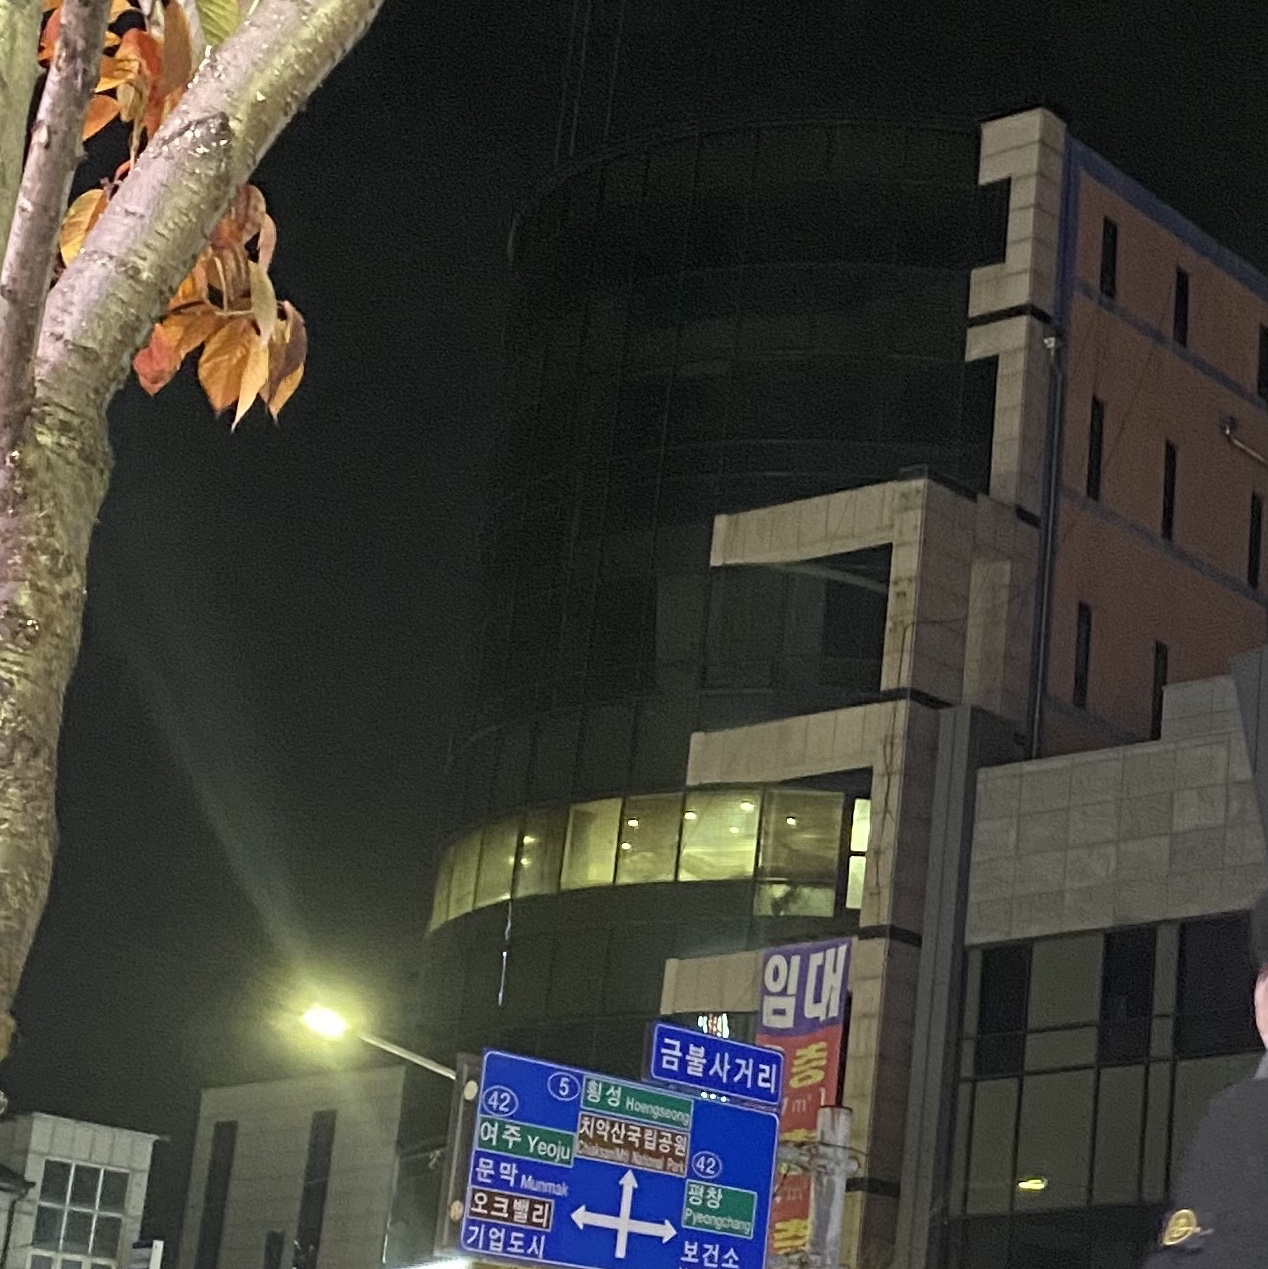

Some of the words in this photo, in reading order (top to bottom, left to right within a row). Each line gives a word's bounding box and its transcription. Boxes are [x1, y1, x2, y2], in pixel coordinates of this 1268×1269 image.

[762, 944, 848, 1028] 임대
[660, 1038, 776, 1094] 금불사거리
[487, 1091, 511, 1113] 42
[558, 1077, 570, 1096] 5
[587, 1080, 622, 1107] 횡성
[625, 1097, 691, 1126] Hoengseong
[480, 1121, 522, 1149] 여주
[527, 1136, 571, 1162] Yeoju
[579, 1117, 687, 1156] 치악산국립공원
[475, 1158, 518, 1187] 문막
[521, 1175, 569, 1197] Munmak
[696, 1156, 716, 1175] 42
[688, 1184, 723, 1209] 평창
[466, 1224, 546, 1259] 기업도시
[680, 1240, 739, 1269] 보건소
